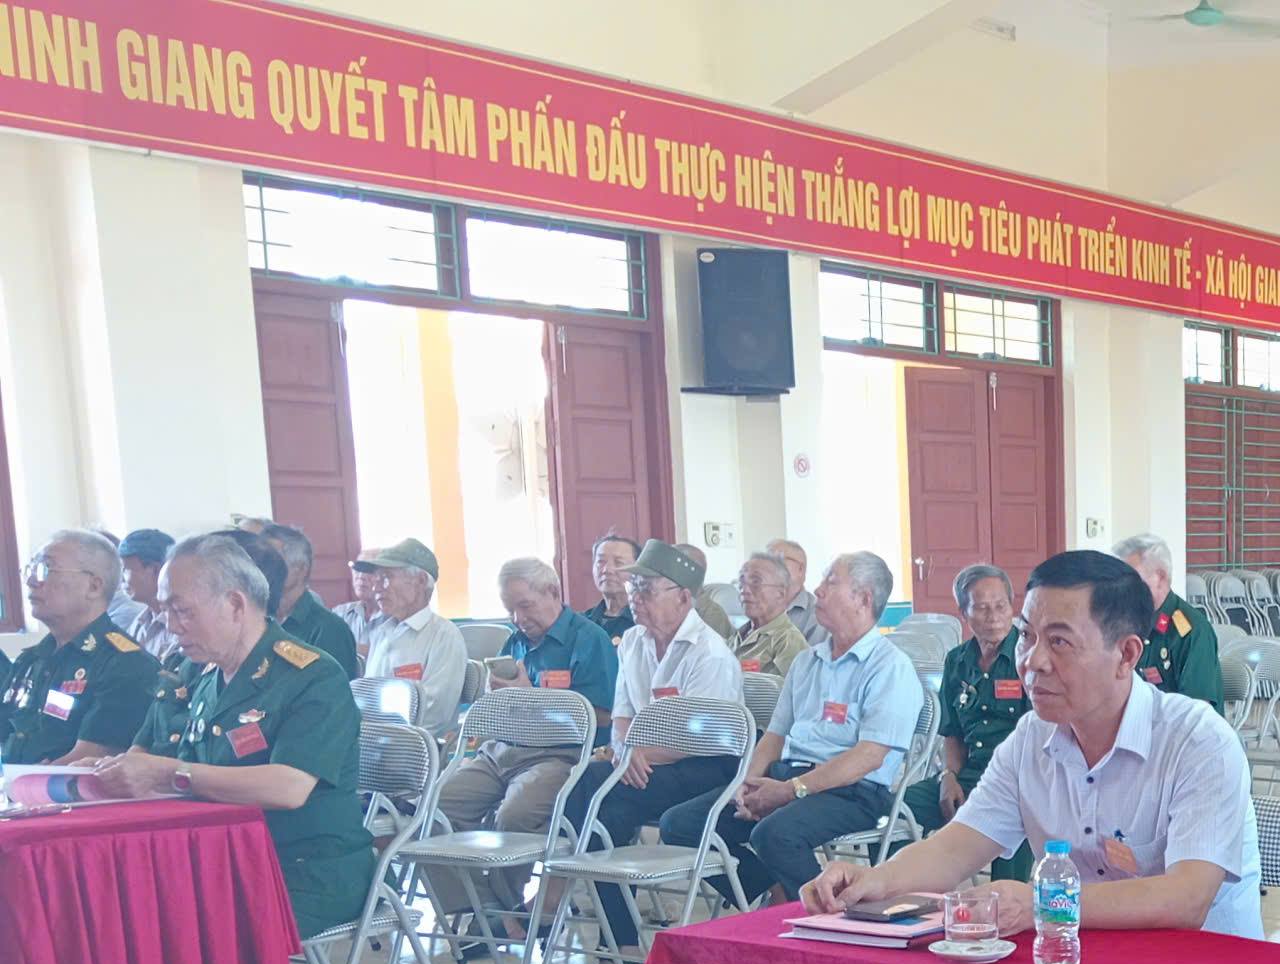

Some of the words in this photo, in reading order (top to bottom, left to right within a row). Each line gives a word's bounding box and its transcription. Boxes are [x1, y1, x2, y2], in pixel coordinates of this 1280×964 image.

[117, 29, 254, 119] GIANG
[268, 57, 387, 141] QUYẾT
[399, 77, 476, 158] TÂM
[487, 95, 577, 177] PHẤN
[586, 111, 646, 189] ĐẤU
[655, 138, 726, 211] THỰC
[735, 150, 795, 224] HIỆN
[802, 157, 880, 231] THẮNG
[887, 186, 920, 248] LỢI
[927, 195, 973, 256] MỤC
[979, 201, 1021, 257] TIÊU
[1027, 213, 1073, 267] PHÁT
[1078, 216, 1127, 277] TRIỂN
[1132, 239, 1169, 285] KINH
[1174, 238, 1192, 289] TẾ
[1196, 271, 1201, 279] -
[1206, 250, 1225, 296] XÃ
[1229, 254, 1251, 308] HỘI
[1255, 266, 1280, 306] GIAI
